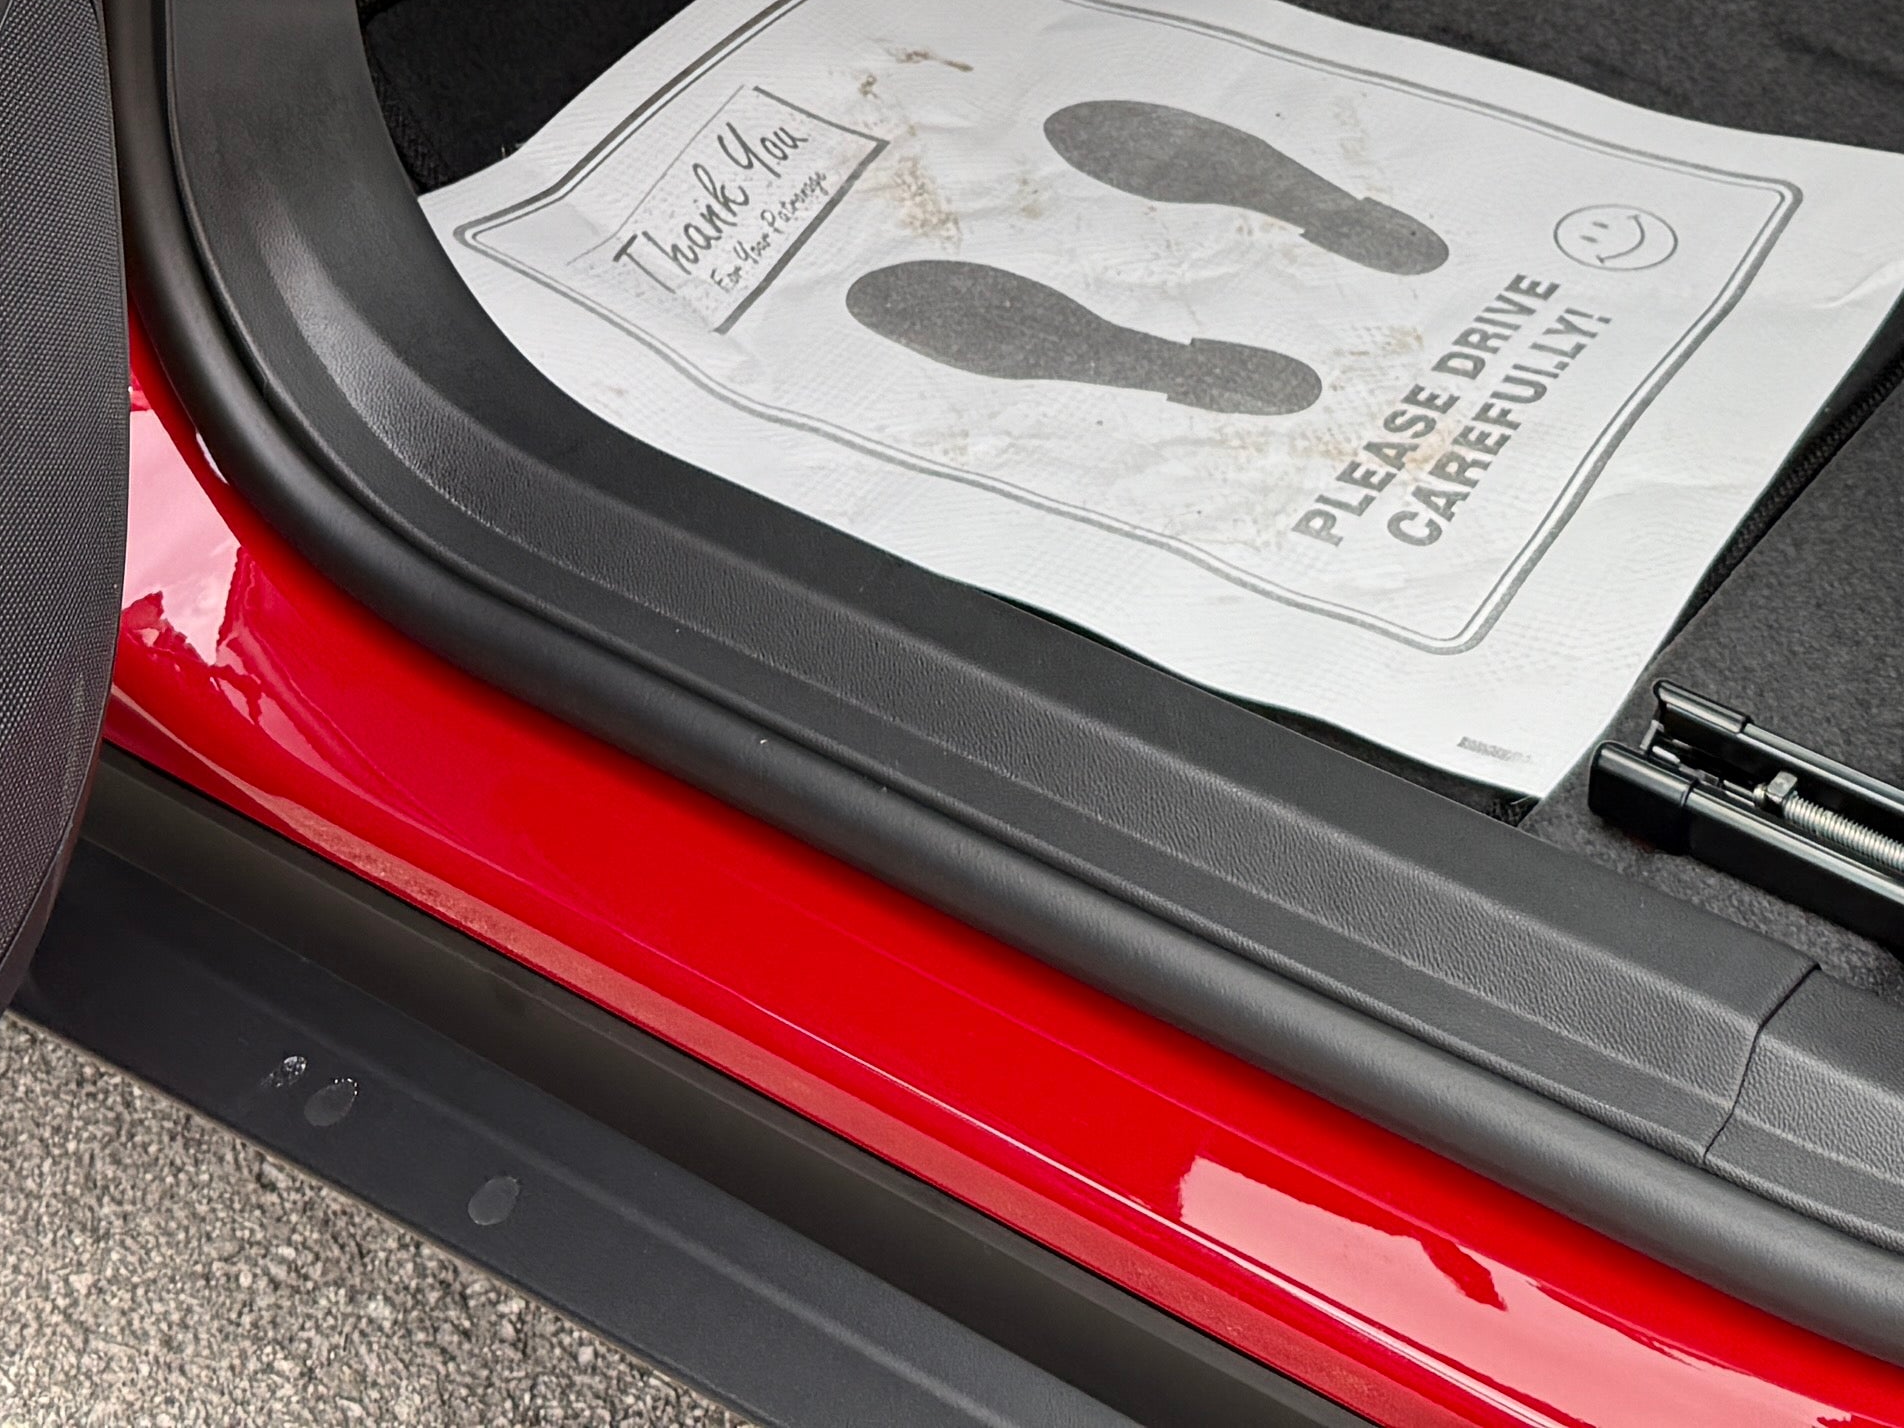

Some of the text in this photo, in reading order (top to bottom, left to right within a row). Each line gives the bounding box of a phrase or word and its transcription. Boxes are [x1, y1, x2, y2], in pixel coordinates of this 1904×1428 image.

[612, 121, 809, 295] Thank You
[1290, 273, 1561, 548] PLEASE DRIVE
[1386, 307, 1613, 548] CAREFULLY!
